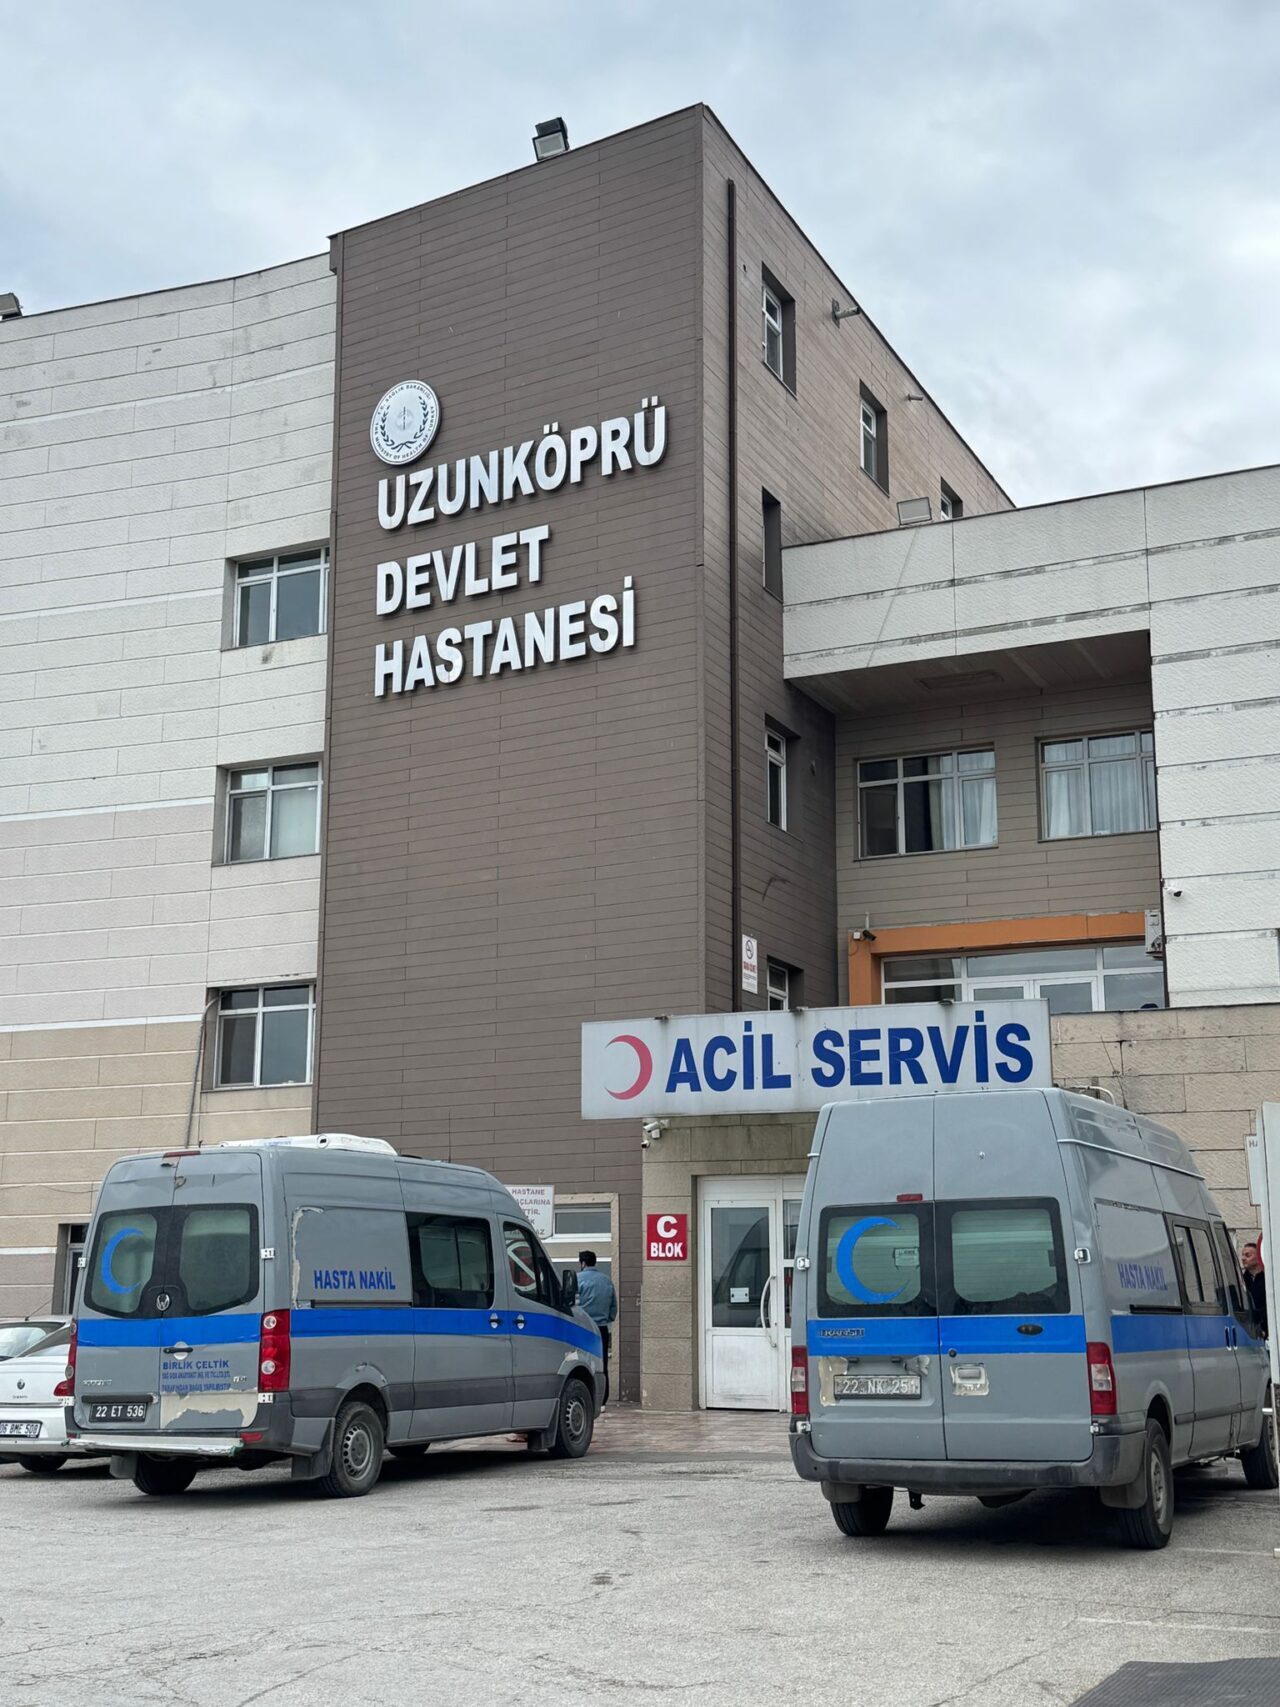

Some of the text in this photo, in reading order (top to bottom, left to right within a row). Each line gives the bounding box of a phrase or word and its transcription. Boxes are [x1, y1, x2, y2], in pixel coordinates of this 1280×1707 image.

[377, 395, 667, 530] UZUNKÖPRÜ
[376, 524, 550, 616] DEVLET
[374, 575, 636, 697] HASTANESİ
[665, 1010, 1034, 1093] ACİL SERVİS
[656, 1215, 678, 1239] C
[650, 1242, 684, 1258] BLOK
[313, 1266, 396, 1290] HASTA NAKİL
[1116, 1263, 1147, 1289] HASTA
[162, 1358, 230, 1370] BİRLİK ÇELTİK
[842, 1379, 916, 1394] 22 NK 251
[95, 1405, 144, 1418] 22 ET 536
